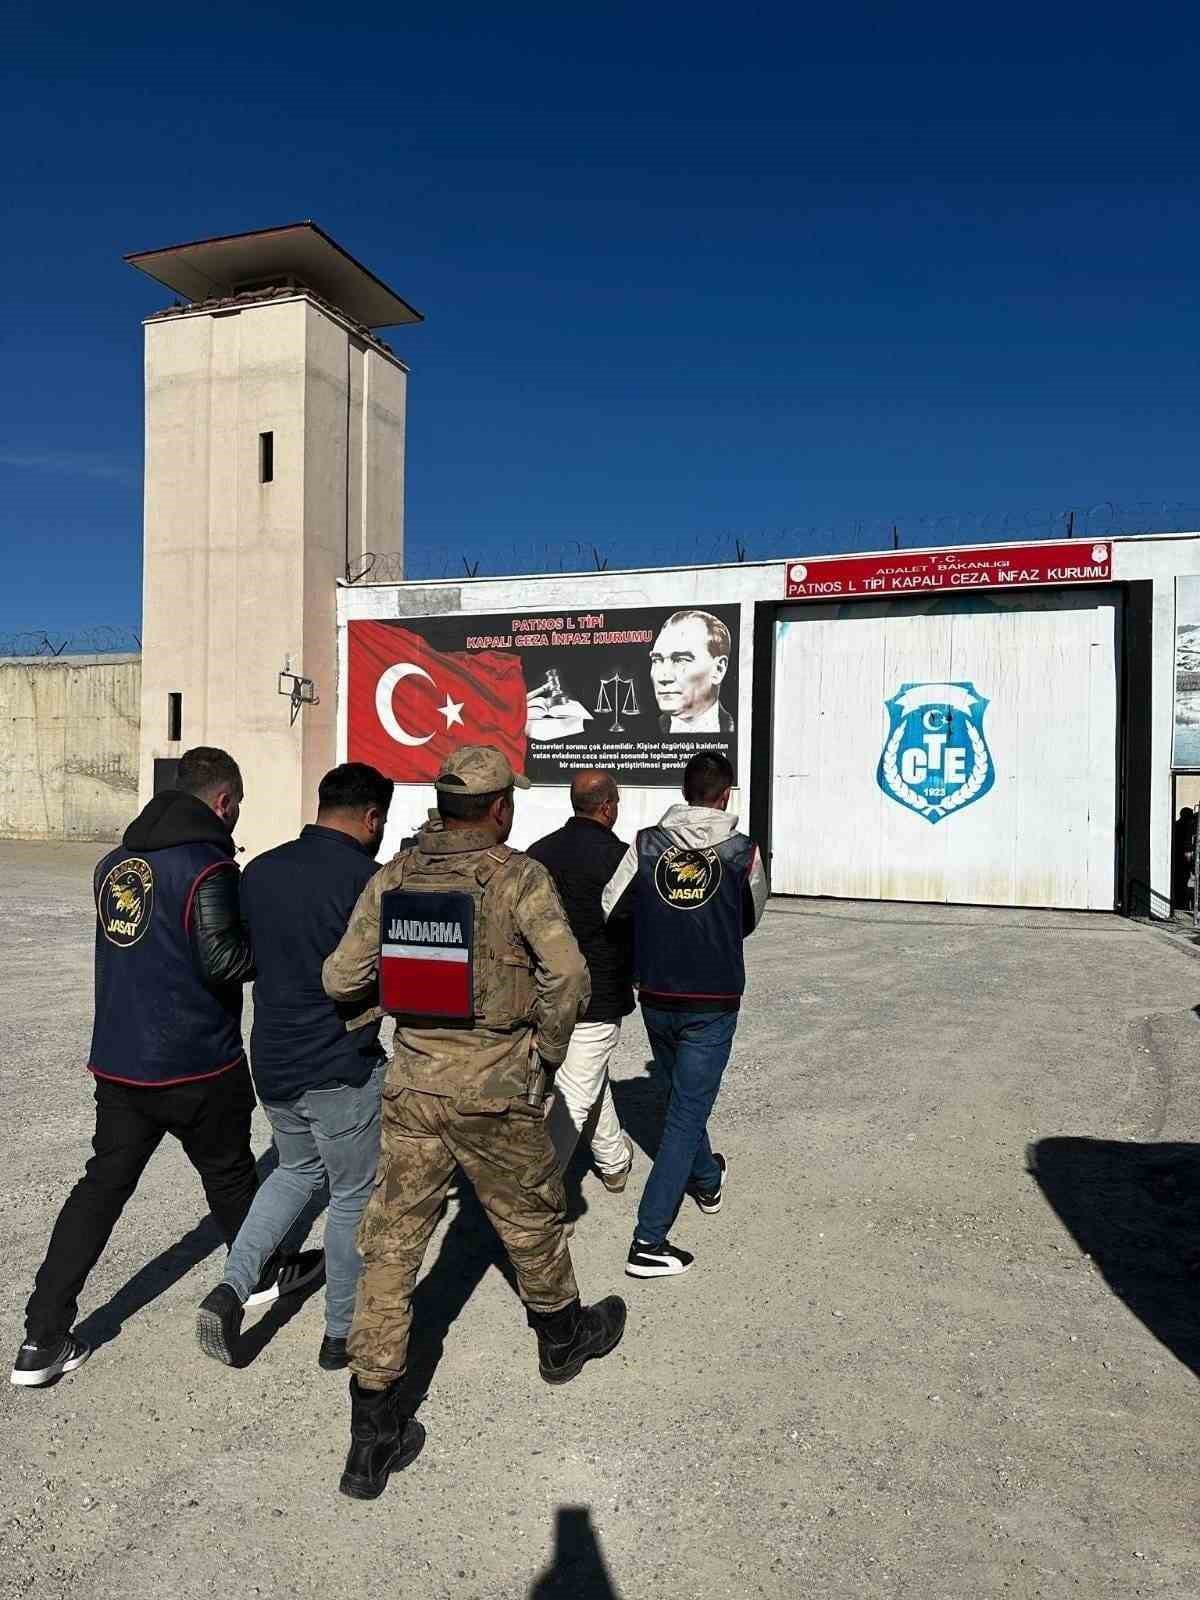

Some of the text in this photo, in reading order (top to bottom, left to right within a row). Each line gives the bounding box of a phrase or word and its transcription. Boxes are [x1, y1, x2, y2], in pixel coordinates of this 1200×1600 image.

[876, 565, 928, 575] ADALET
[789, 565, 1109, 595] PATNOS L TİPİ KAPALI CEZA İNFAZ KURUMU
[511, 614, 604, 632] PATNOS L TİPİ
[466, 630, 653, 649] KAPALI CEZA İNFAZ KURUMU
[588, 743, 602, 751] çok
[668, 888, 706, 900] JASAT
[107, 919, 138, 936] JASAT
[388, 918, 463, 944] JANDARMA
